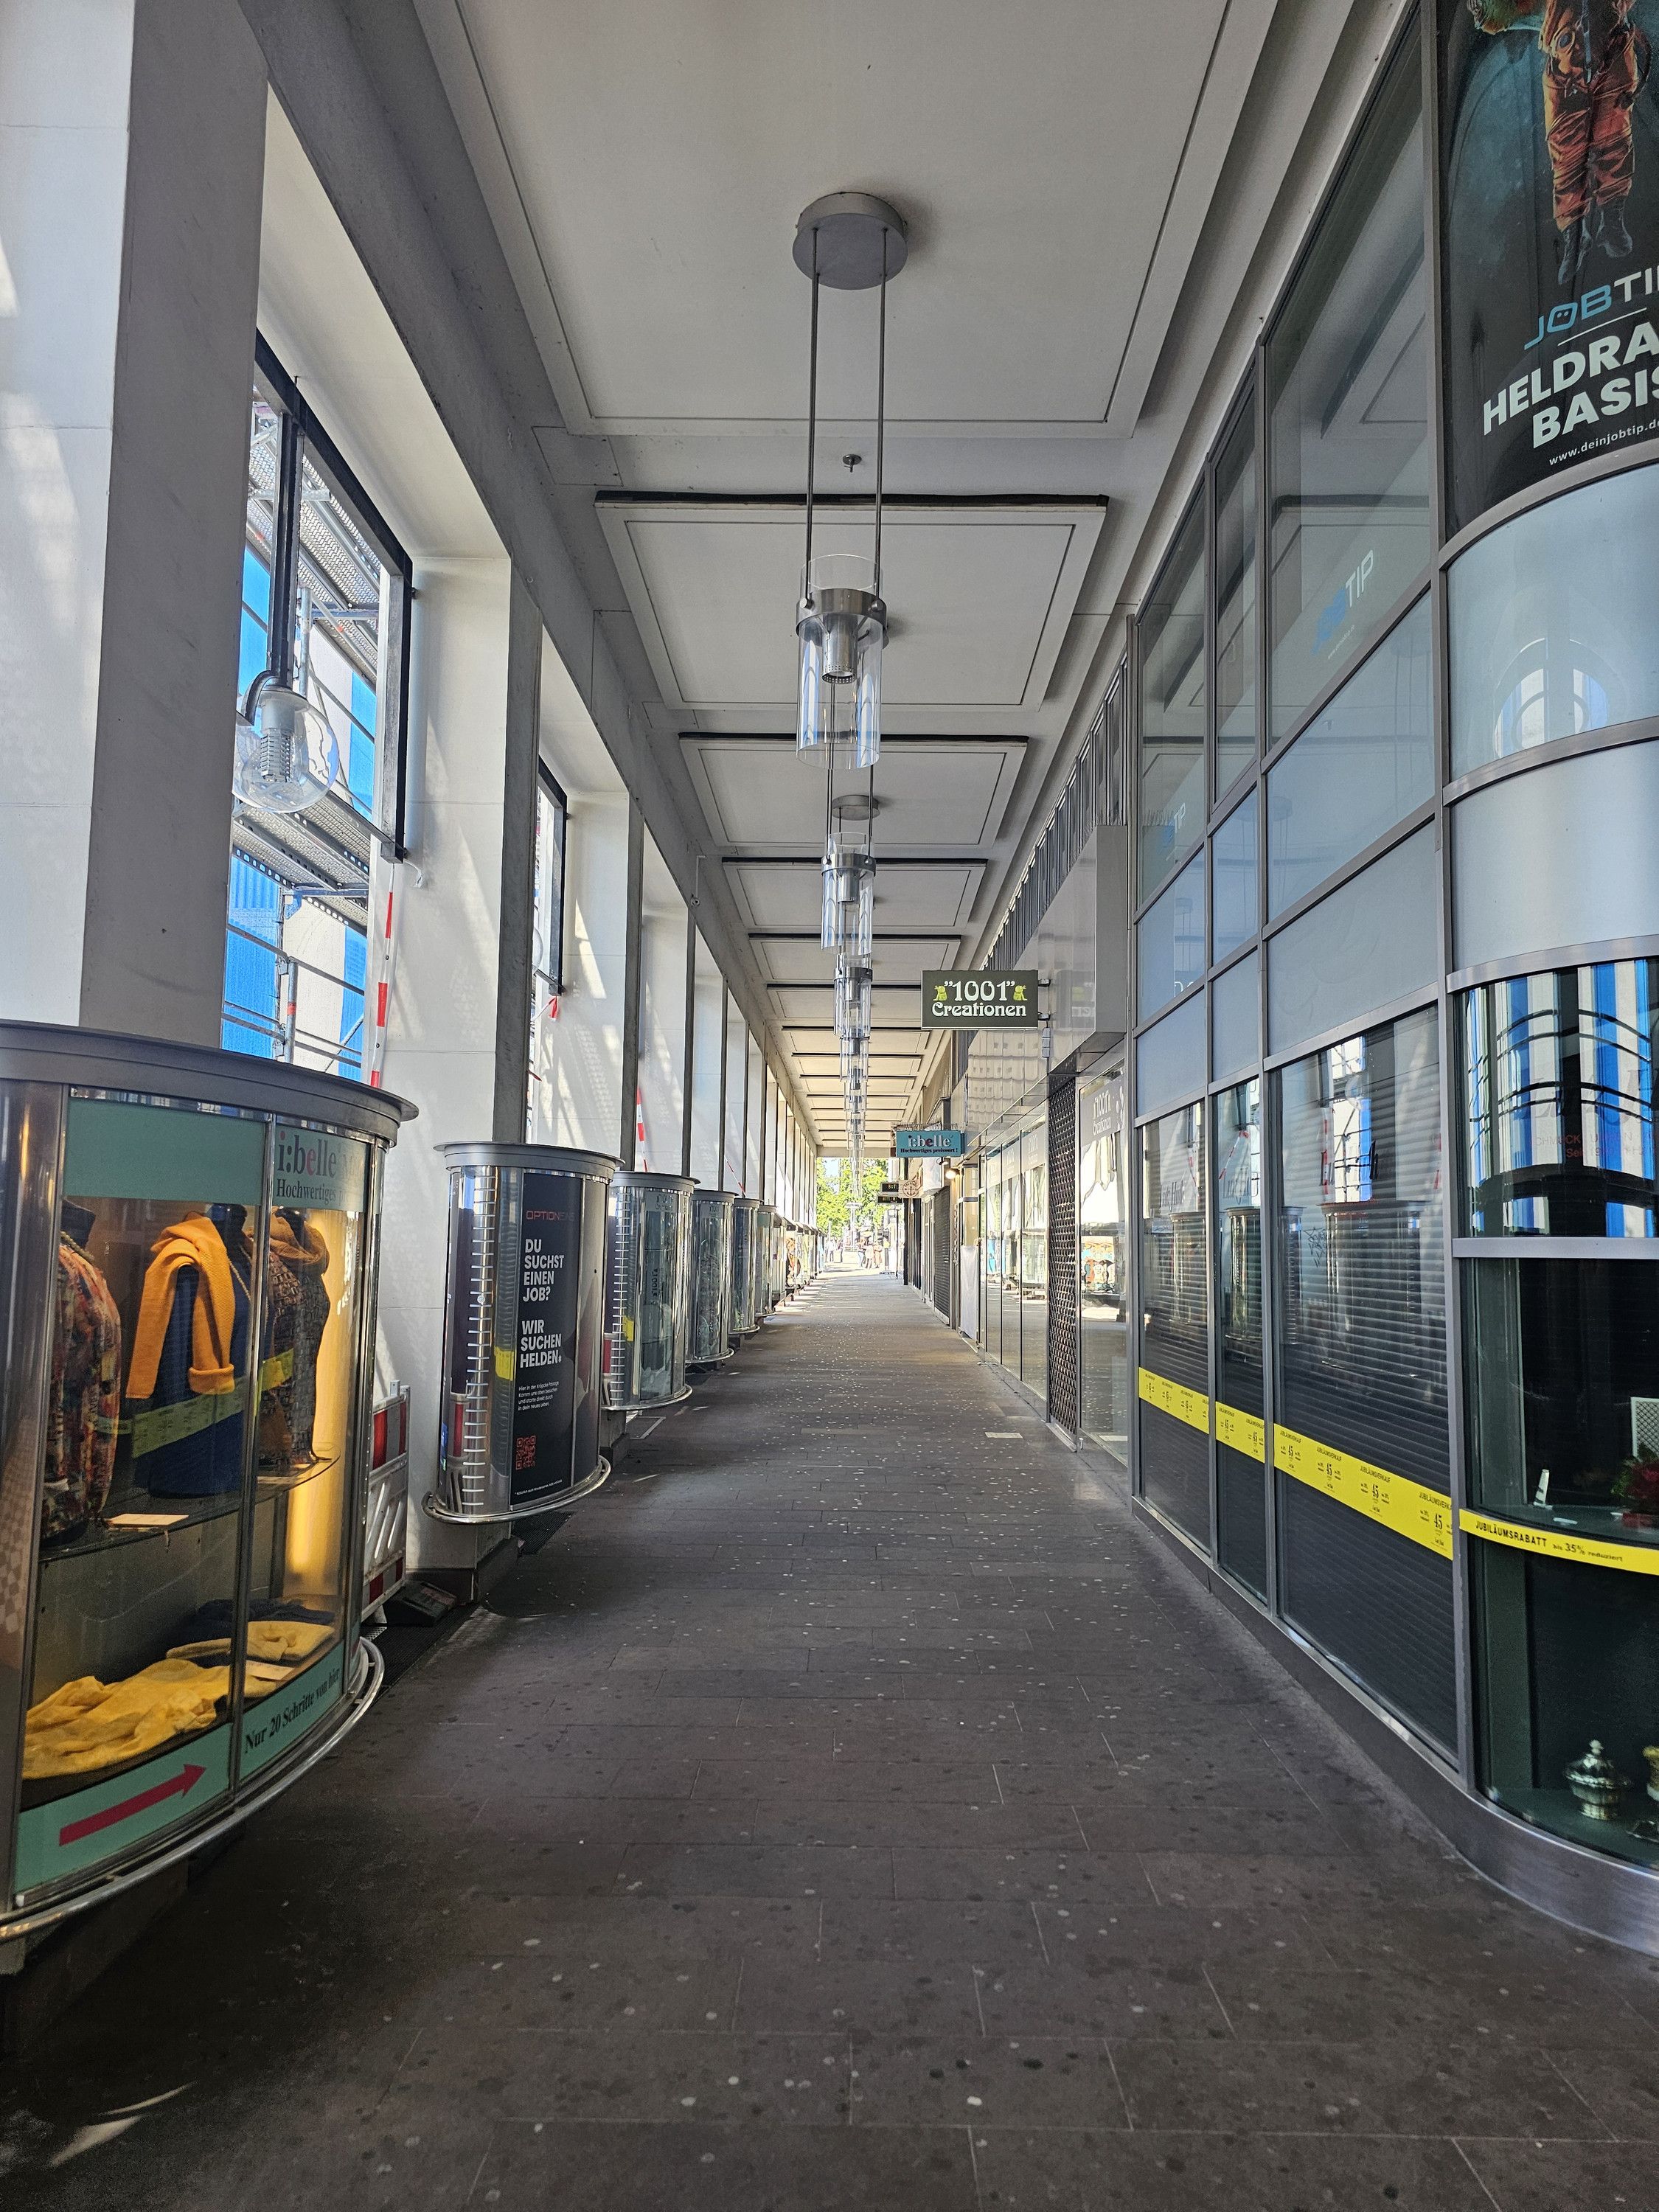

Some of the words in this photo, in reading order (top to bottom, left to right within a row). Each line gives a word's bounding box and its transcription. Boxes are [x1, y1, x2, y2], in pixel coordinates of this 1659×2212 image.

[1524, 265, 1659, 350] JOBTI
[1534, 367, 1659, 448] BASI
[932, 1002, 1026, 1017] Creationen
[276, 1178, 337, 1205] Hochwertiges
[525, 1239, 542, 1253] DU
[524, 1255, 564, 1269] SUCHST
[524, 1270, 554, 1285] EINEN
[523, 1286, 551, 1301] JOB?
[521, 1319, 545, 1335] WIR
[521, 1333, 562, 1352] SUCHEN
[1372, 1484, 1379, 1498] 45
[1433, 1513, 1443, 1530] 45
[1476, 1520, 1547, 1547] JUBILÄUMSRABATT
[1565, 1542, 1585, 1555] 35%
[245, 1728, 267, 1753] Nur
[268, 1714, 281, 1738] 20
[282, 1692, 315, 1727] Schritte
